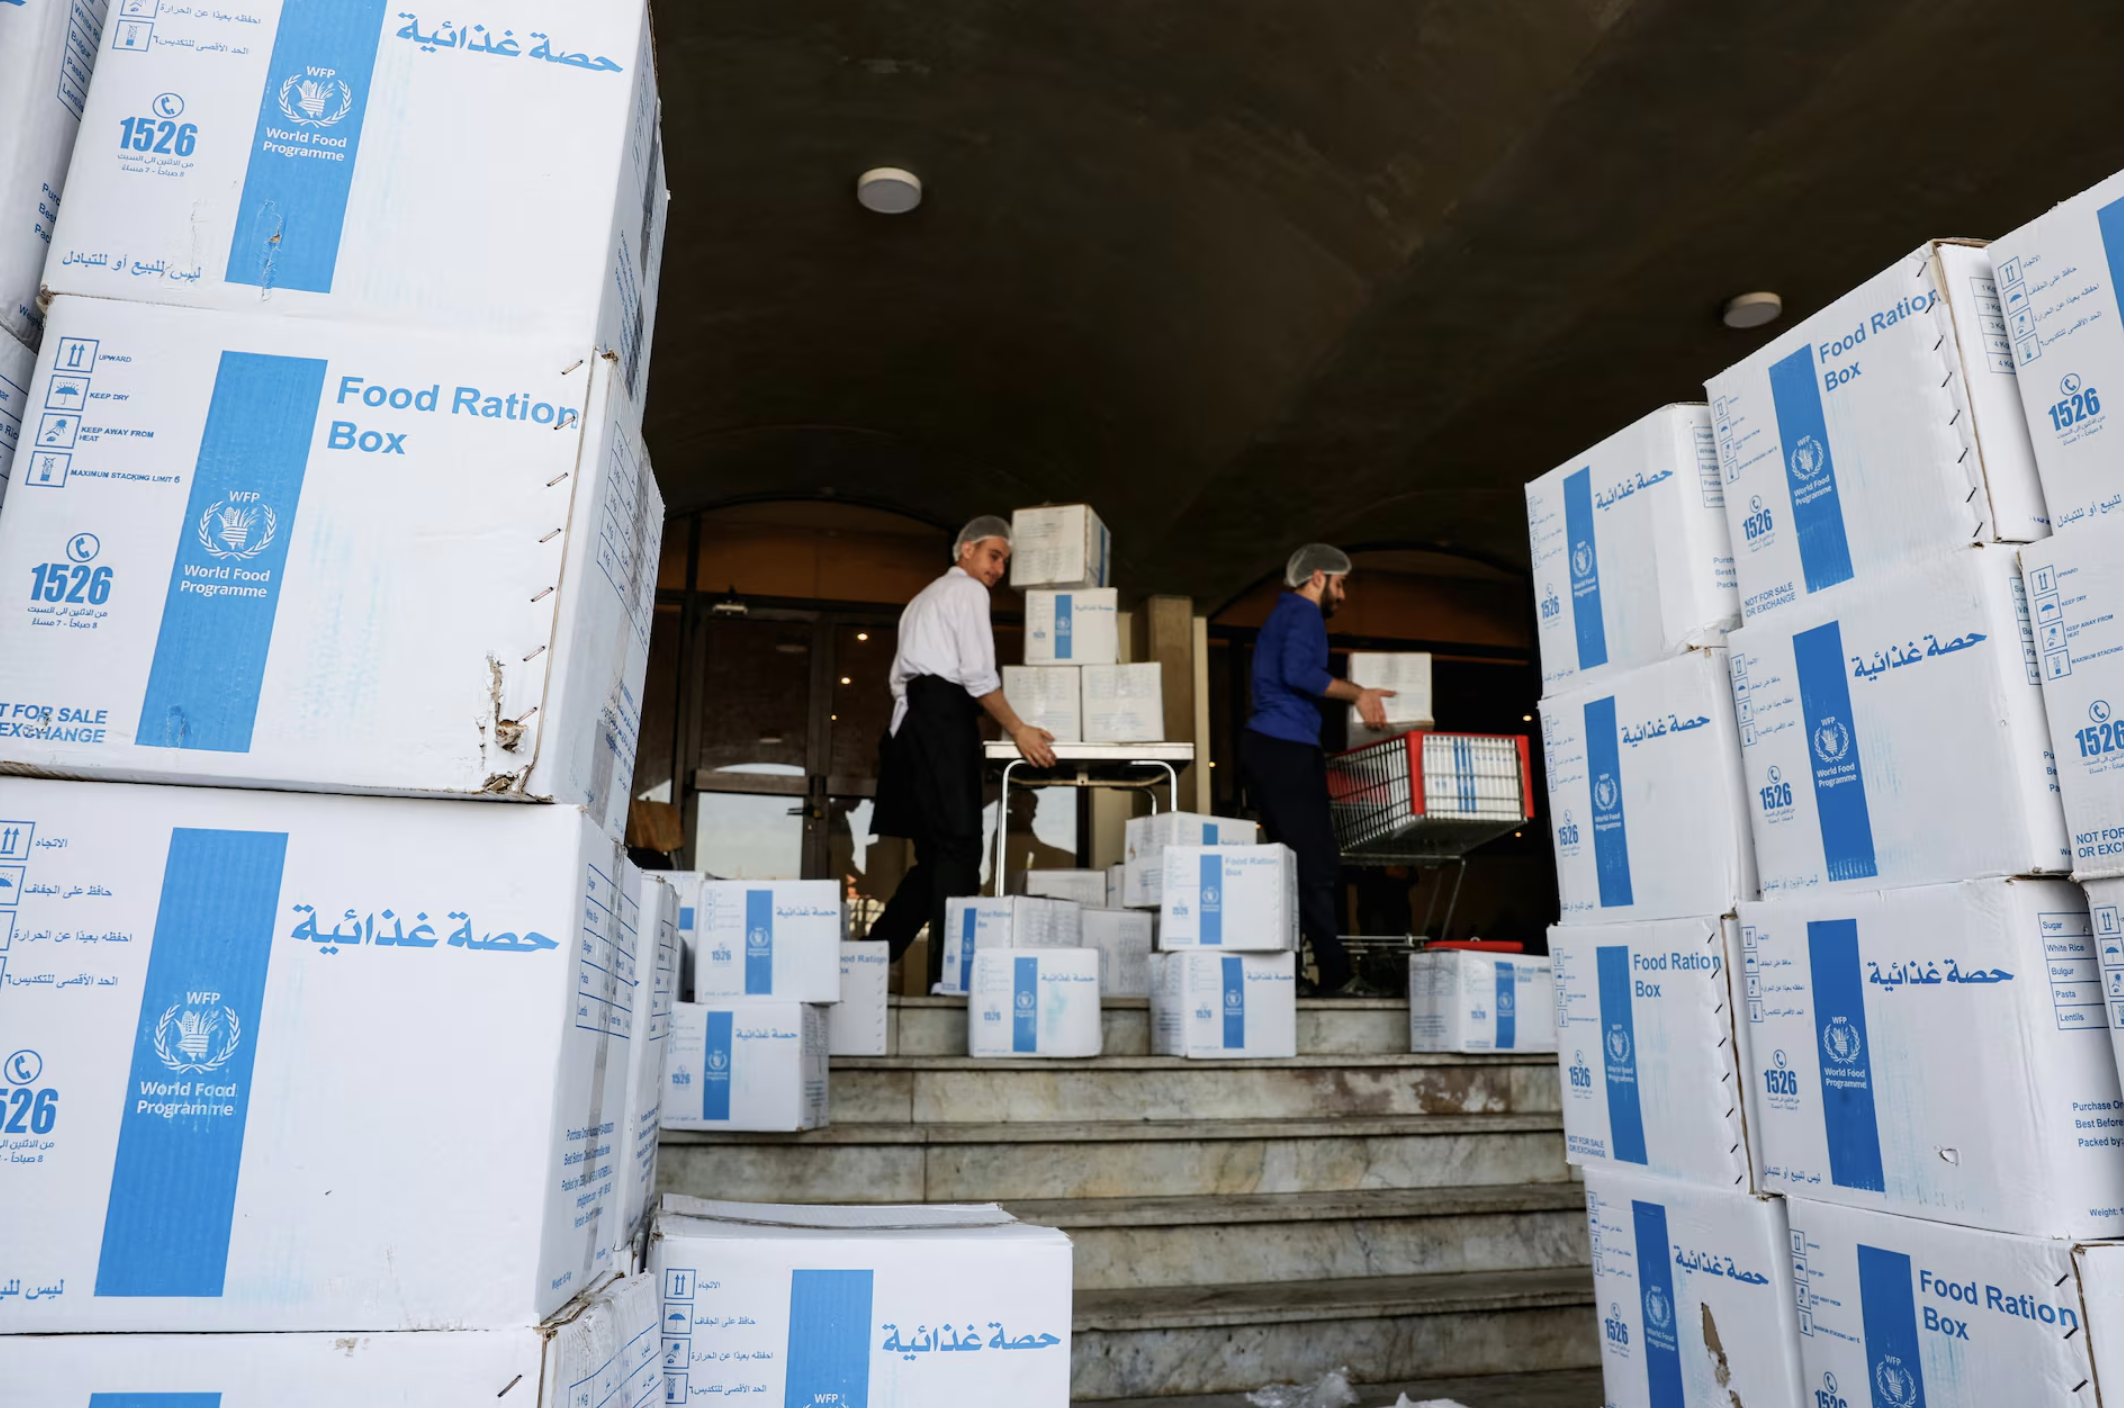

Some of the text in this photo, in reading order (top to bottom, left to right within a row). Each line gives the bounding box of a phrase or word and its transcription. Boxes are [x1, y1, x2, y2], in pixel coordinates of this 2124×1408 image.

[396, 11, 624, 73] حصة غذائية
[67, 56, 85, 84] Pasta
[305, 65, 335, 79] WFP
[120, 116, 199, 157] 1526
[265, 127, 347, 148] World Food
[262, 141, 345, 162] Programme
[62, 251, 202, 282] ليس للبيع أو للتبادل
[1818, 288, 1942, 365] Food Ration
[98, 354, 132, 363] UPWARD
[1823, 360, 1862, 393] Box
[89, 392, 130, 401] KEEP DRY
[336, 376, 580, 430] Food Ration
[2048, 387, 2102, 432] 1526
[79, 434, 99, 442] HEAT
[80, 426, 155, 438] KEEP AWAY FROM
[326, 420, 408, 455] Box
[1796, 435, 1811, 447] WFP
[70, 469, 181, 484] MAXIMUM STACKING LIMIT 6
[1595, 469, 1674, 512] حصة غذائية
[1793, 474, 1831, 498] World Food
[1794, 484, 1832, 506] Programme
[229, 490, 260, 503] WFP
[2057, 493, 2122, 528] للبيع أو للتبادل
[1742, 508, 1773, 541] 1526
[183, 563, 271, 582] World Food
[2056, 567, 2079, 579] UPWARD
[30, 562, 114, 605] 1526
[179, 580, 268, 599] Programme
[1744, 581, 1794, 607] NOT FOR SALE
[2061, 594, 2087, 607] KEEP DRY
[27, 605, 56, 614] السبت
[1540, 595, 1560, 620] 1526
[1746, 591, 1796, 618] OR EXCHANGE
[94, 611, 108, 619] من
[2066, 614, 2114, 633] KEEP AWAY FROM
[2066, 630, 2080, 639] HEAT
[1851, 632, 1988, 682] حصة غذائية
[2071, 645, 2124, 665] MAXIMUM STACKING
[12, 704, 52, 723] FOR
[57, 706, 109, 725] SALE
[1820, 716, 1836, 727] WFP
[0, 722, 107, 744] EXCHANGE
[1621, 714, 1711, 748] حصة غذائية
[2074, 719, 2124, 758] 1526
[1816, 762, 1856, 779] World Food
[1817, 773, 1857, 788] Programme
[1759, 782, 1793, 811] 1526
[35, 838, 68, 850] الاتجاه
[1558, 824, 1579, 846] 1526
[2076, 827, 2124, 845] NOT FOR
[2078, 846, 2095, 858] OR
[24, 884, 113, 899] حافظ على الجفاف
[776, 906, 838, 919] حصة غذائية
[290, 903, 560, 956] حصة غذائية
[2042, 921, 2063, 931] Sugar
[13, 929, 51, 942] الحرارة
[54, 931, 71, 943] عن
[101, 931, 133, 943] احفظه
[711, 950, 732, 961] 1526
[2046, 943, 2085, 953] White Rice
[1633, 952, 1722, 971] Food Ration
[1866, 958, 2015, 992] حصة غذائية
[2051, 967, 2074, 976] Bulgur
[56, 973, 94, 989] الأقصى
[97, 976, 119, 986] الحد
[1635, 980, 1662, 998] Box
[185, 991, 221, 1005] WFP
[2055, 990, 2076, 999] Pasta
[1831, 1016, 1848, 1025] WFP
[2059, 1012, 2084, 1022] Lentils
[735, 1028, 798, 1041] حصة غذائية
[671, 1072, 691, 1085] 1526
[1568, 1065, 1591, 1088] 1526
[1824, 1067, 1866, 1079] World Food
[140, 1080, 236, 1098] World Food
[1763, 1068, 1797, 1097] 1526
[1825, 1076, 1867, 1090] Programme
[136, 1100, 234, 1118] Programme
[2072, 1101, 2112, 1111] Purchase
[2075, 1119, 2095, 1130] Best
[2078, 1137, 2108, 1148] Packed
[2089, 1208, 2119, 1218] Weight:
[1672, 1245, 1770, 1285] حصة غذائية
[25, 1279, 65, 1300] ليس
[698, 1281, 721, 1290] الاتجاه
[1919, 1269, 2079, 1329] Food Ration
[694, 1316, 756, 1328] حافظ على الجفاف
[1922, 1306, 1970, 1342] Box
[1604, 1318, 1629, 1346] 1526
[882, 1322, 1062, 1361] حصة غذائية
[1884, 1353, 1902, 1368] WFP
[814, 1394, 839, 1404] WFP
